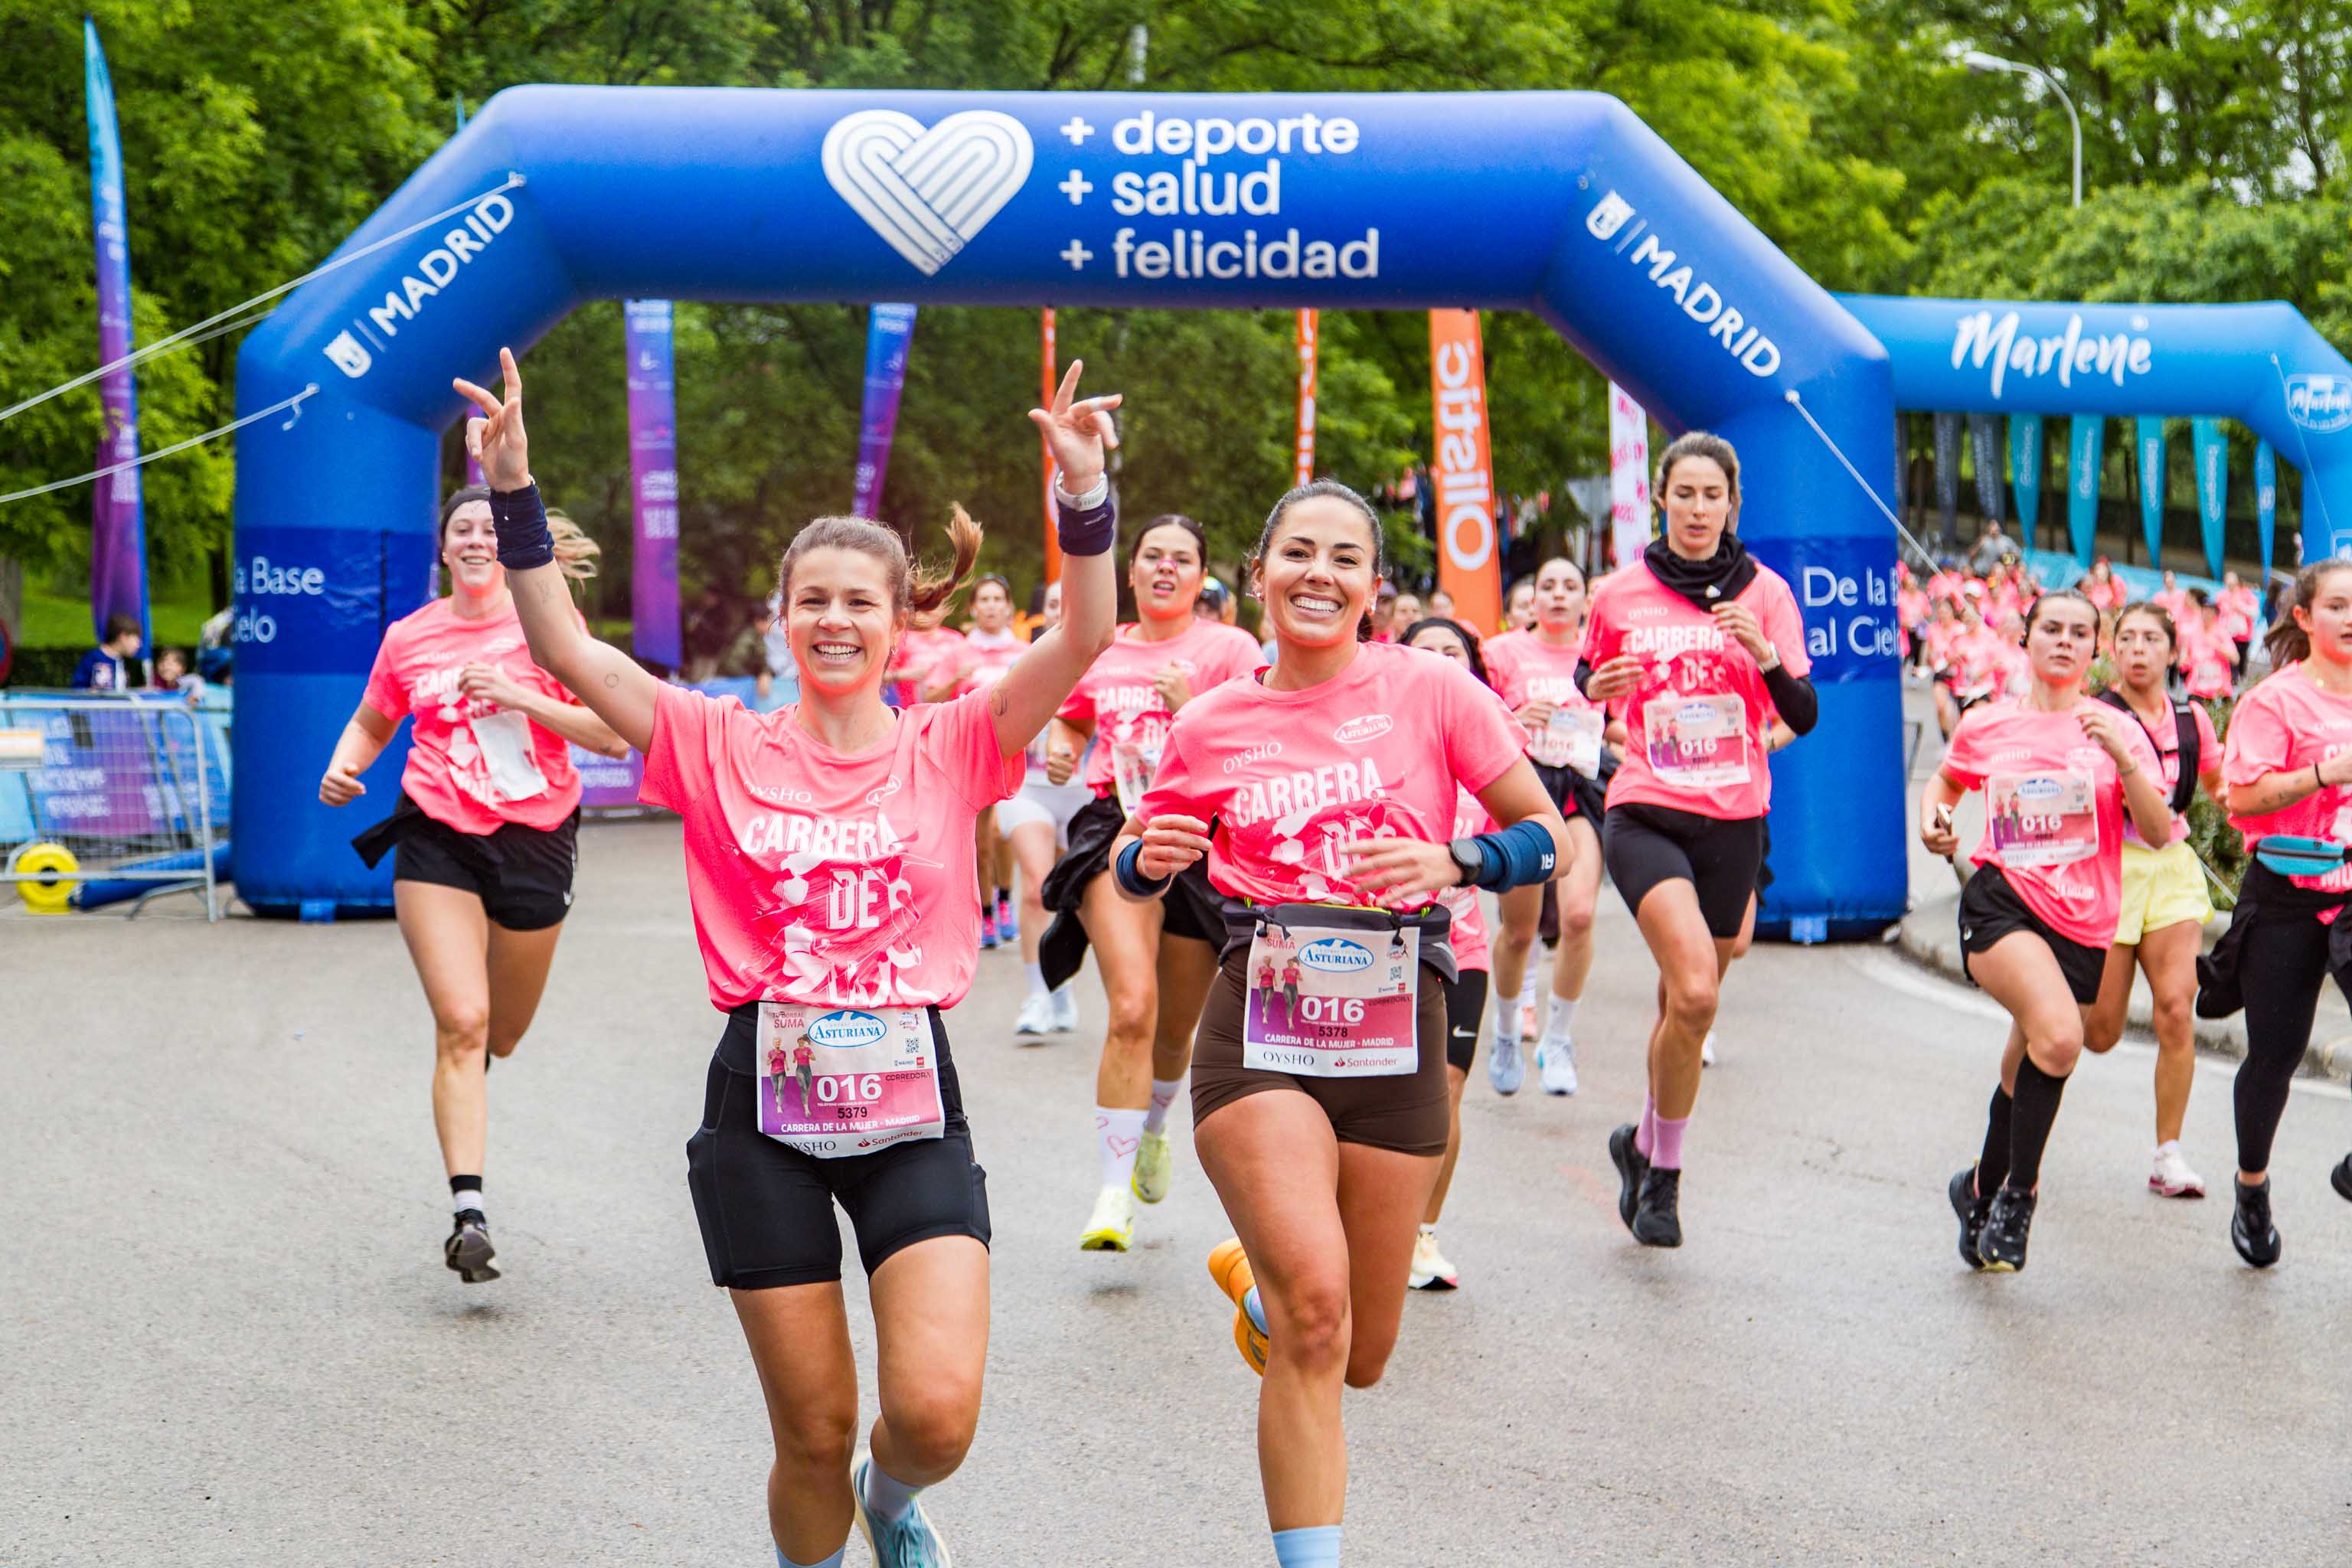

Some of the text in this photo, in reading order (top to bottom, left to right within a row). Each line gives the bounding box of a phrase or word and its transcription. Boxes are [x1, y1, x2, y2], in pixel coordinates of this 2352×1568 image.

[1112, 109, 1361, 167] deporte
[1112, 158, 1281, 216] salud
[368, 194, 515, 337] MADRID
[1112, 227, 1379, 279] felicidad
[1630, 233, 1782, 377] MADRID
[251, 555, 325, 596] Base
[1803, 566, 1858, 607] De
[1866, 566, 1887, 606] la
[1808, 616, 1838, 657] al
[1340, 719, 1390, 740] ASTURIANA
[1223, 741, 1282, 774] OYSHO
[1680, 740, 1718, 757] 016
[1234, 758, 1387, 828] CARRERA
[2021, 814, 2063, 833] 016
[826, 867, 886, 930] DE
[1304, 949, 1368, 965] ASTURIANA
[1302, 997, 1364, 1023] 016
[773, 1018, 805, 1029] SUMA
[815, 1025, 881, 1040] ASTURIANA
[1318, 1026, 1348, 1037] 5378
[1265, 1034, 1302, 1044] CARRERA
[1304, 1037, 1314, 1047] DE
[1316, 1038, 1326, 1048] LA
[1328, 1038, 1356, 1049] MUJER
[1361, 1037, 1394, 1047] MADRID
[1263, 1051, 1397, 1067] OYSHO Santander
[817, 1072, 931, 1102] 016 CORREDORA
[781, 1123, 821, 1133] CARRERA
[822, 1122, 834, 1132] DE
[835, 1122, 848, 1132] LA
[849, 1120, 878, 1131] MUJER
[884, 1115, 920, 1127] MADRID
[837, 1106, 867, 1119] 5379
[871, 1131, 923, 1146] Santander
